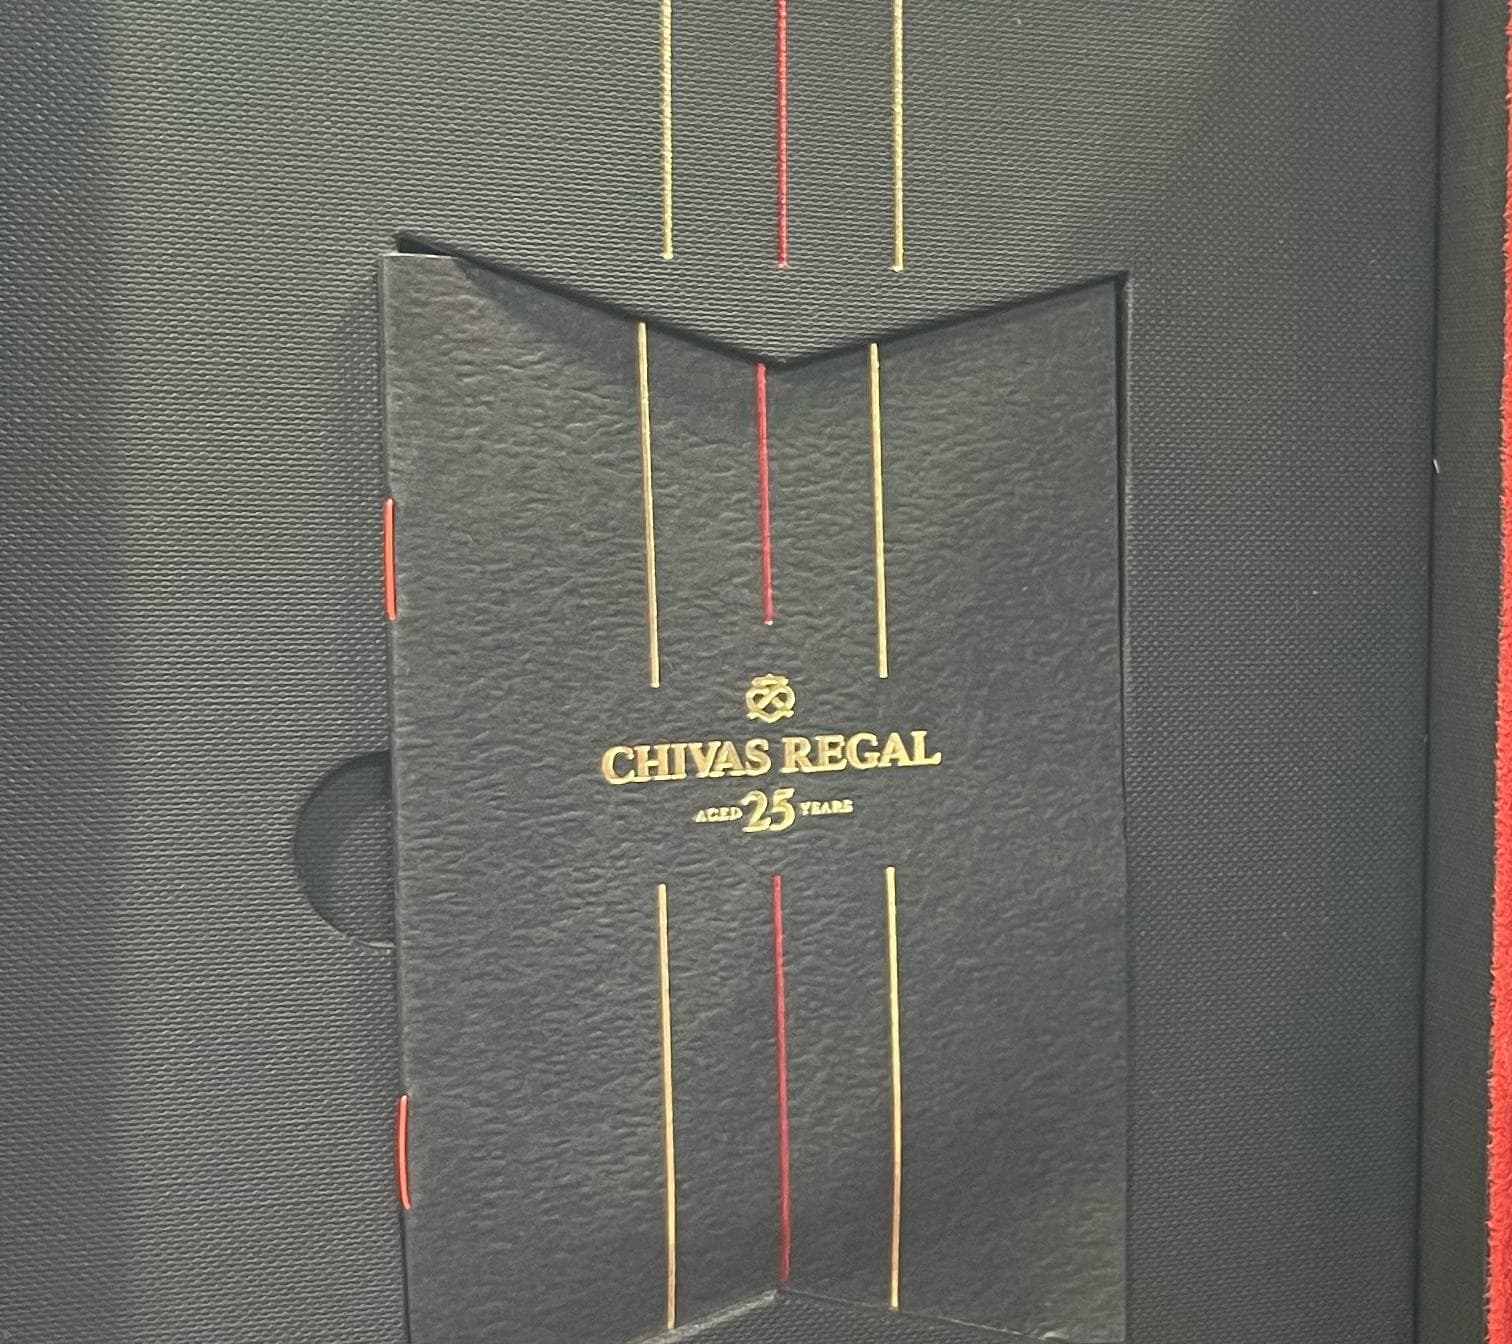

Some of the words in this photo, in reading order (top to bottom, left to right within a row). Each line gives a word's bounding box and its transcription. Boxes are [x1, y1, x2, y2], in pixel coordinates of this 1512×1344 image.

[602, 738, 772, 785] CHIVAS
[781, 730, 943, 775] REGAL
[694, 805, 743, 823] AGED
[741, 788, 797, 833] 25
[800, 798, 854, 817] YEARS
